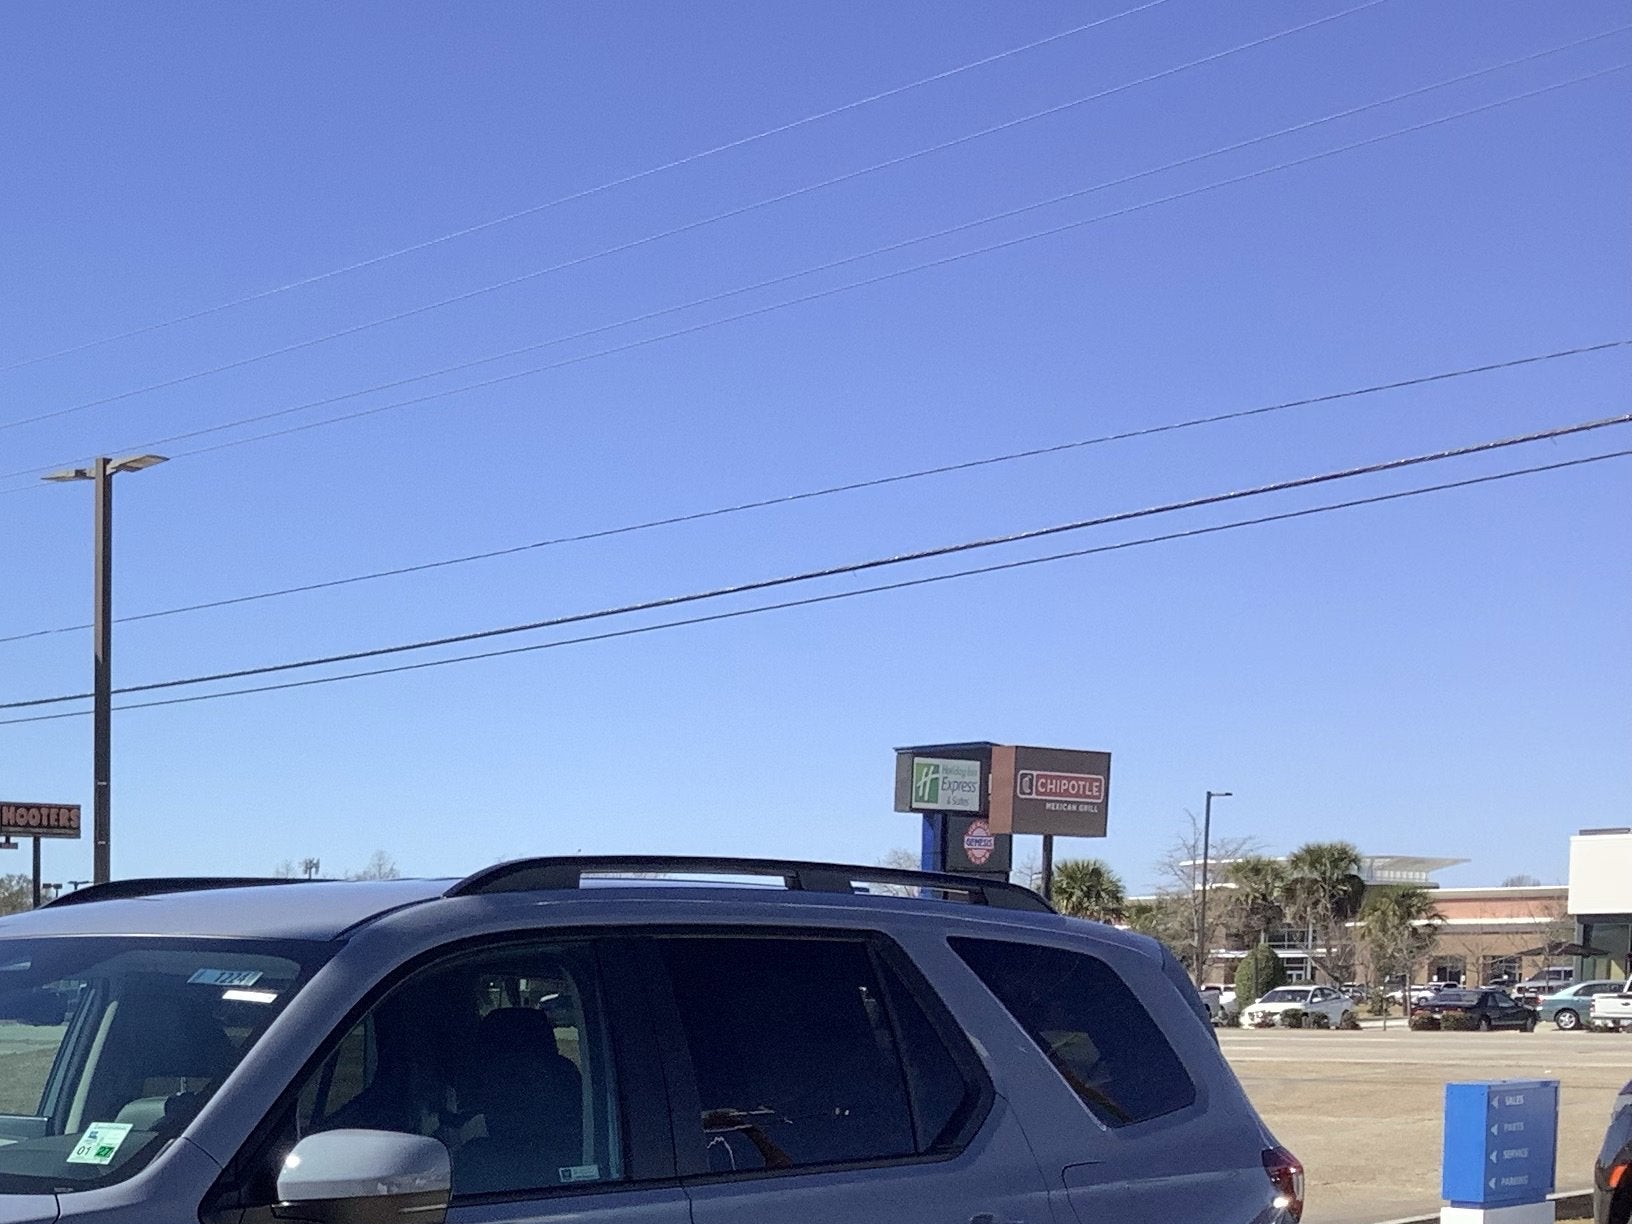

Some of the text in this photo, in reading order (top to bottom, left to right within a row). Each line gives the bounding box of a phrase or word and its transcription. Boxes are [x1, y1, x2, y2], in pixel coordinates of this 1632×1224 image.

[941, 776, 977, 795] Express
[1037, 778, 1100, 796] CHIPOTLE
[1, 805, 80, 828] HOOTERS
[1046, 802, 1098, 813] MEXICAN GRILL
